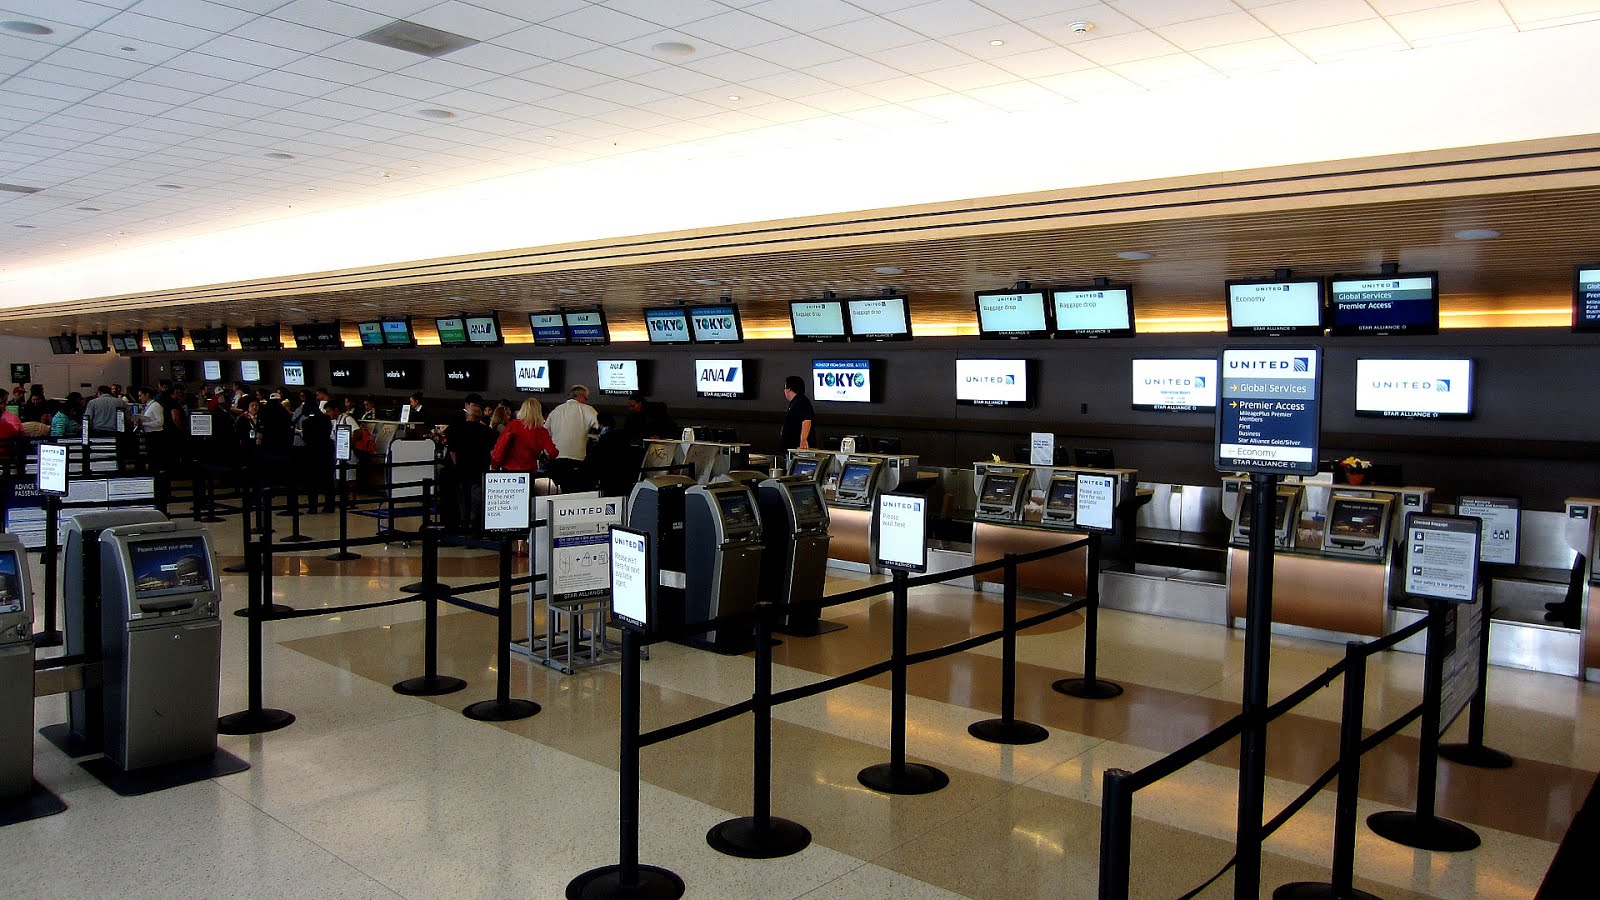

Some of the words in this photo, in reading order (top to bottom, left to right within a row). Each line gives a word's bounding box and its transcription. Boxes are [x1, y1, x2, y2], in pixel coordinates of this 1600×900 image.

[1338, 292, 1360, 300] Global
[1338, 302, 1368, 310] Premier
[650, 319, 684, 331] TOKYO
[695, 318, 732, 330] TOKYO
[471, 324, 486, 334] ANA
[448, 371, 464, 379] volaris
[518, 368, 536, 378] ANA
[700, 369, 724, 382] ANA
[817, 372, 864, 387] TOKYO
[1240, 384, 1266, 392] Global
[1269, 384, 1306, 392] Services
[1240, 401, 1273, 410] Premier
[1276, 402, 1305, 410] Access
[1237, 448, 1276, 457] Economy
[559, 508, 602, 516] UNITED
[615, 538, 637, 548] UNITED
